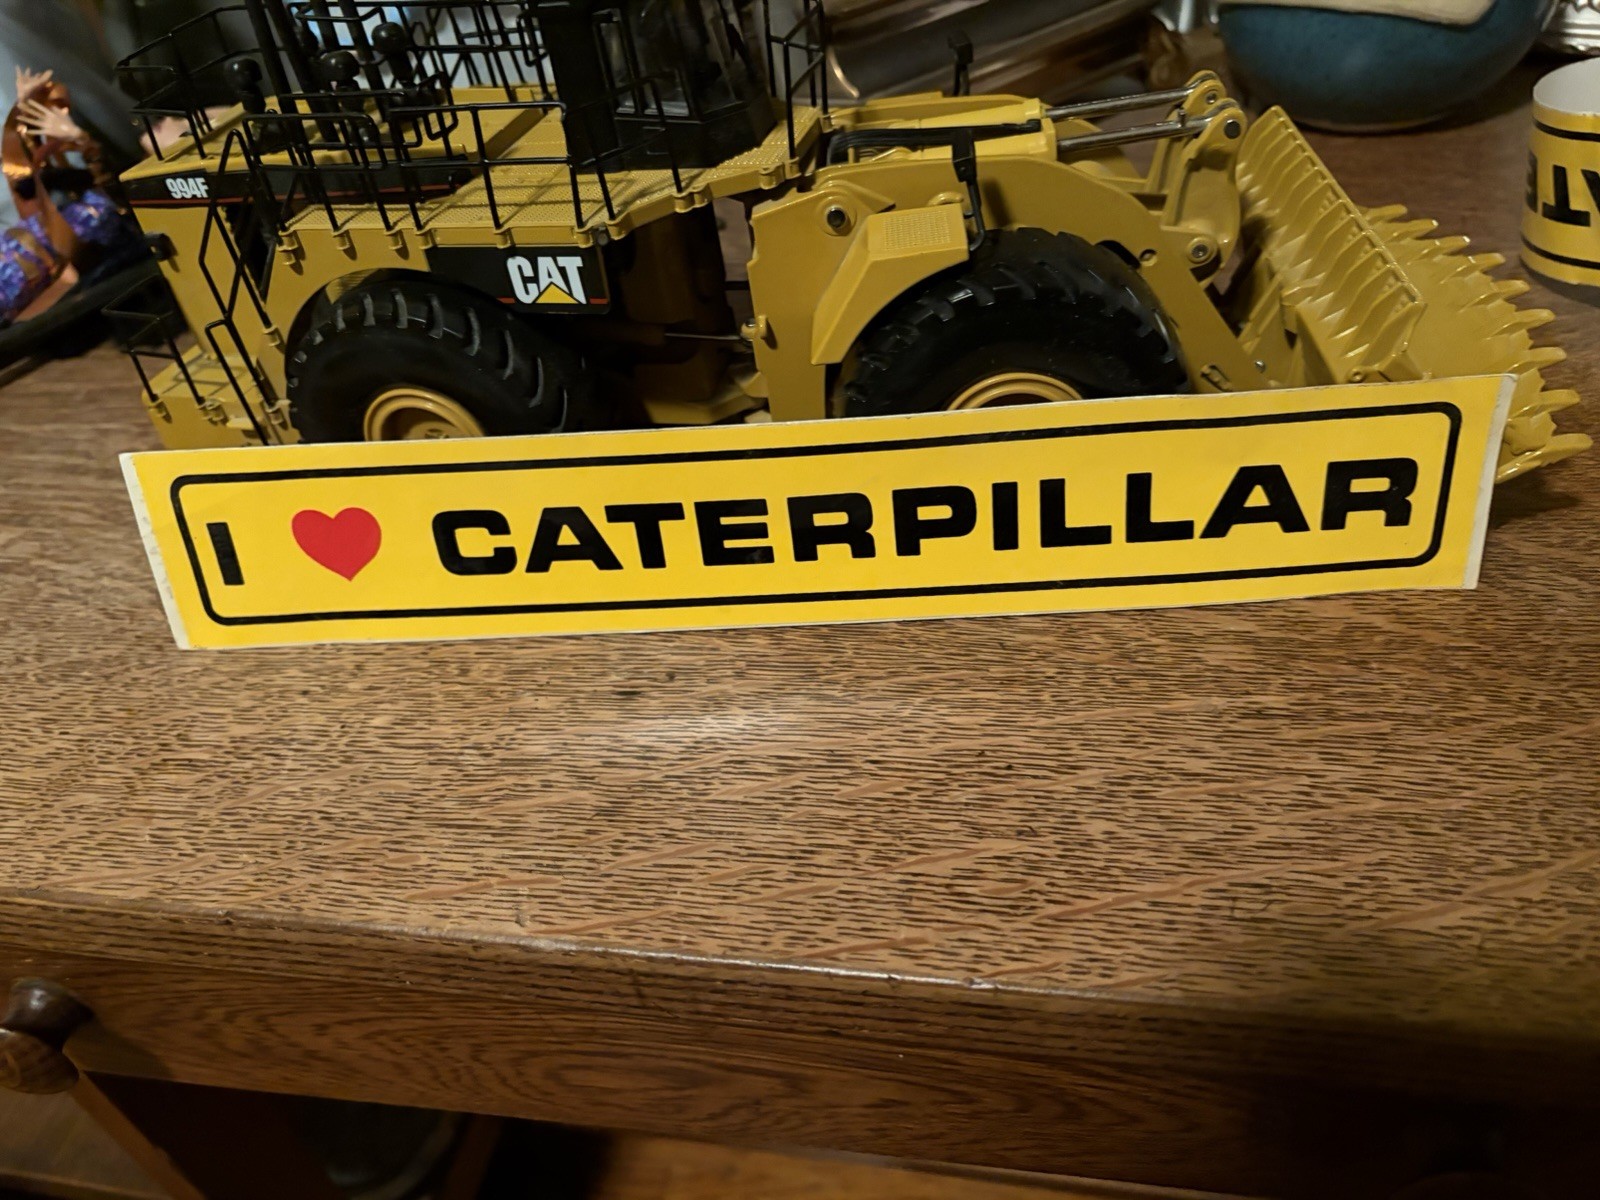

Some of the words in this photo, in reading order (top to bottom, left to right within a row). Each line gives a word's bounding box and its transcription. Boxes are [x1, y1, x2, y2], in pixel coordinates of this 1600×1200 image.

[165, 177, 209, 199] 994F
[506, 256, 587, 304] CAT
[206, 521, 245, 586] I
[431, 457, 1419, 576] CATERPILLAR
